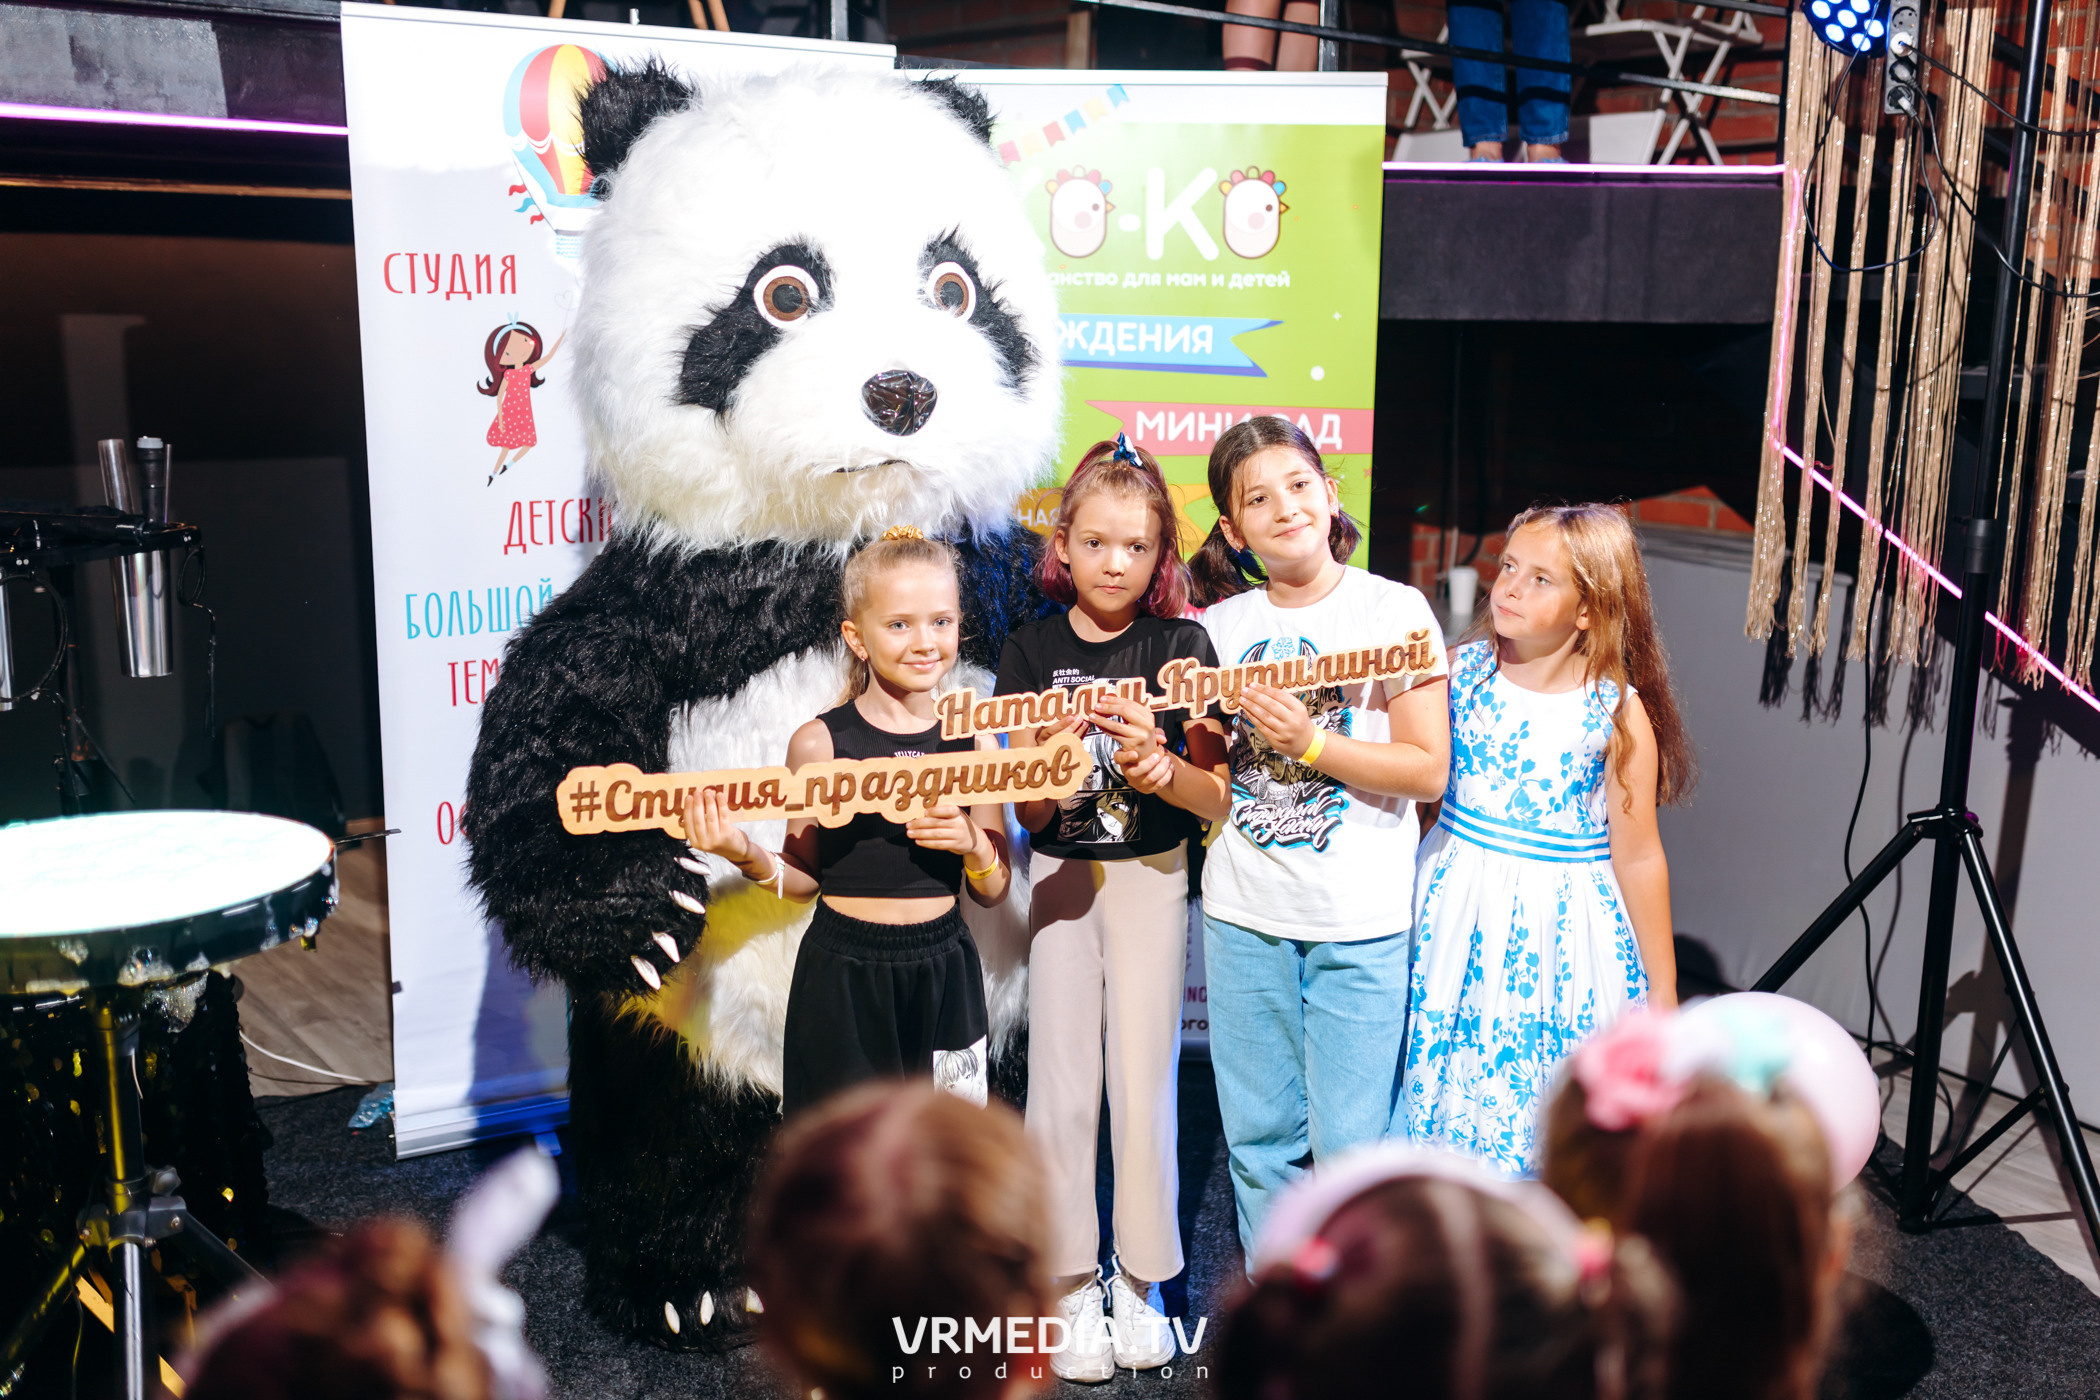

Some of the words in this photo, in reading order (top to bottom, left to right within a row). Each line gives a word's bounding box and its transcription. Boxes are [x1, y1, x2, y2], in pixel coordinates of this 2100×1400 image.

[383, 252, 517, 301] СТУДИЯ
[1122, 272, 1161, 288] для
[1166, 272, 1207, 287] мам
[1211, 273, 1224, 287] и
[1228, 270, 1290, 290] детей
[405, 577, 553, 640] БОЛЬШОЙ
[1070, 675, 1095, 683] SOCIAL
